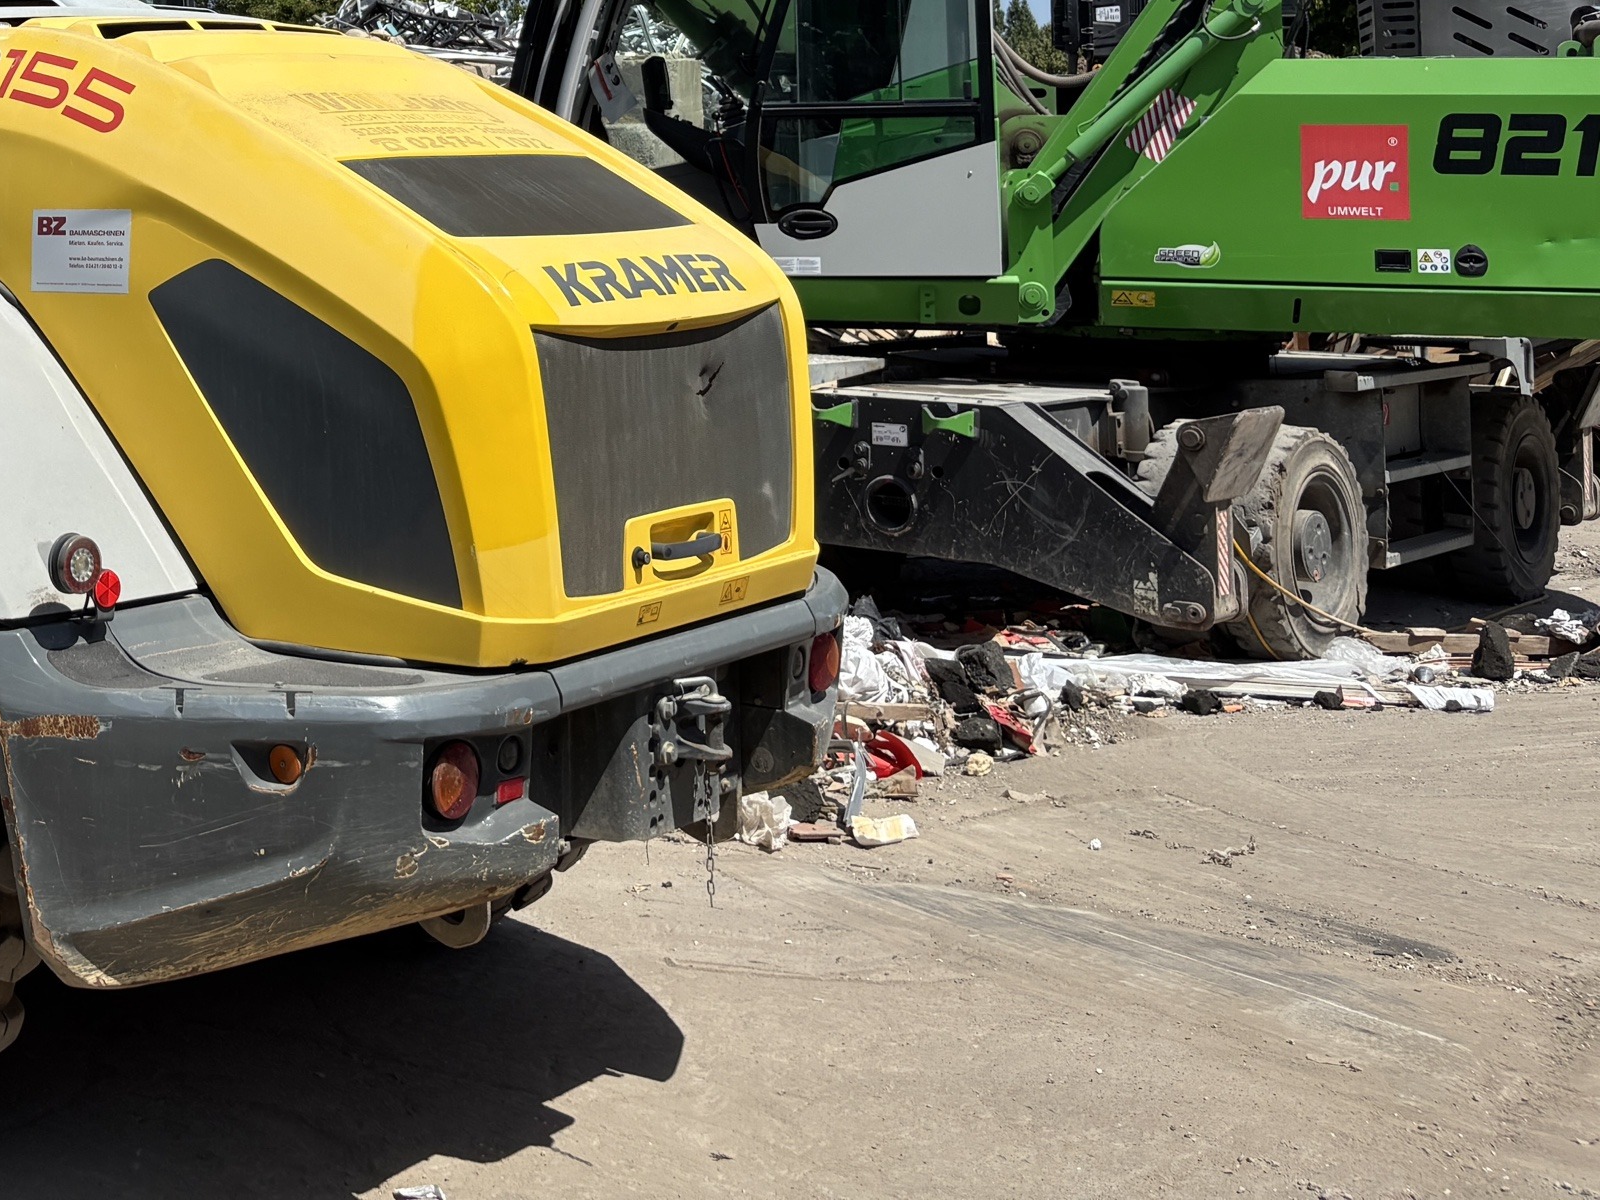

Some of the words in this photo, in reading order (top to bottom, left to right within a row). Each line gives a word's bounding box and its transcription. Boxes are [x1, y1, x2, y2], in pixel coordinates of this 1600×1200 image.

[405, 136, 486, 148] 02474
[495, 136, 554, 149] 1072
[1327, 206, 1384, 217] UMWELT
[37, 216, 67, 236] BZ
[69, 229, 125, 237] BAUMASCHINEN
[1159, 249, 1200, 257] GREEN
[542, 253, 746, 307] KRAMER
